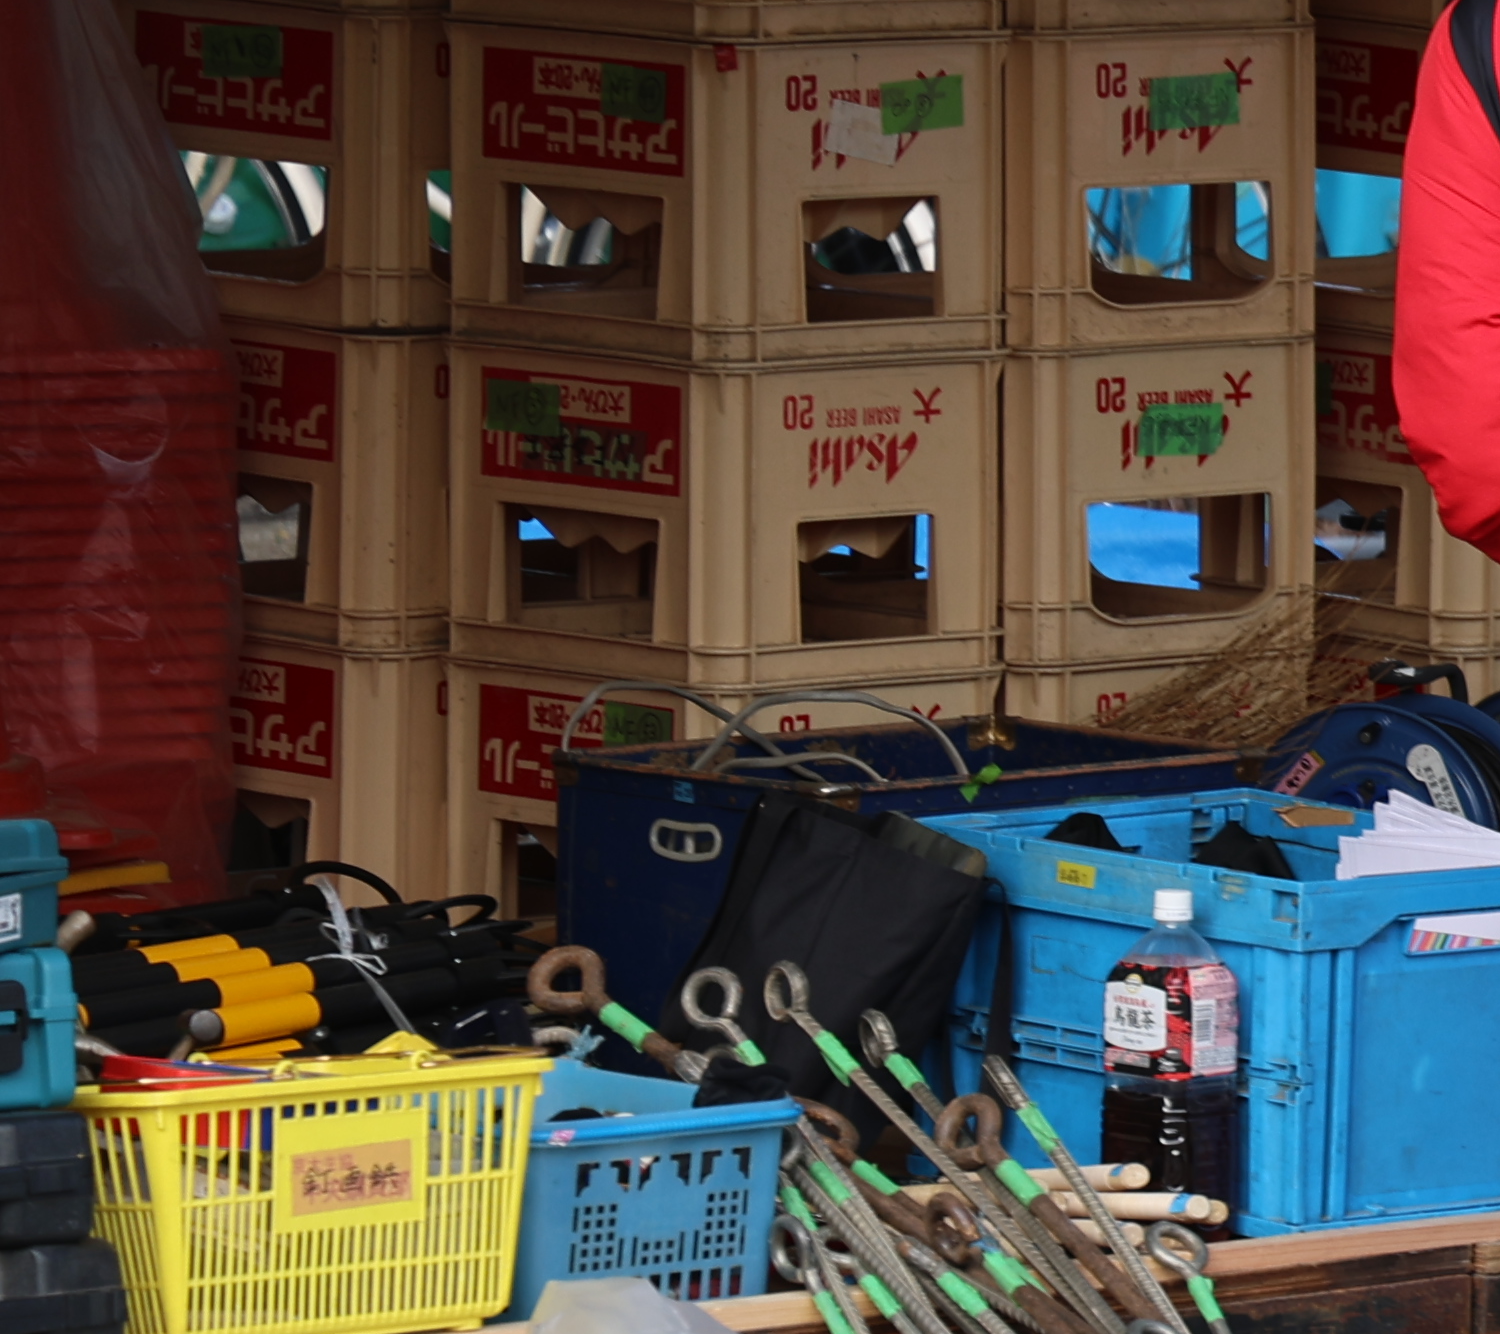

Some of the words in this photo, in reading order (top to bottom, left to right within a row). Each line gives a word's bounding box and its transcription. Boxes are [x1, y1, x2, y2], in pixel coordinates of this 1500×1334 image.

[785, 74, 817, 111] 20
[1096, 62, 1126, 99] 20
[488, 100, 681, 165] アサヒビール
[910, 386, 942, 424] 大
[1096, 377, 1126, 414] 20
[1222, 370, 1253, 408] 大
[236, 391, 329, 451] アサヒ
[782, 394, 814, 431] 20
[807, 430, 918, 489] Asahi
